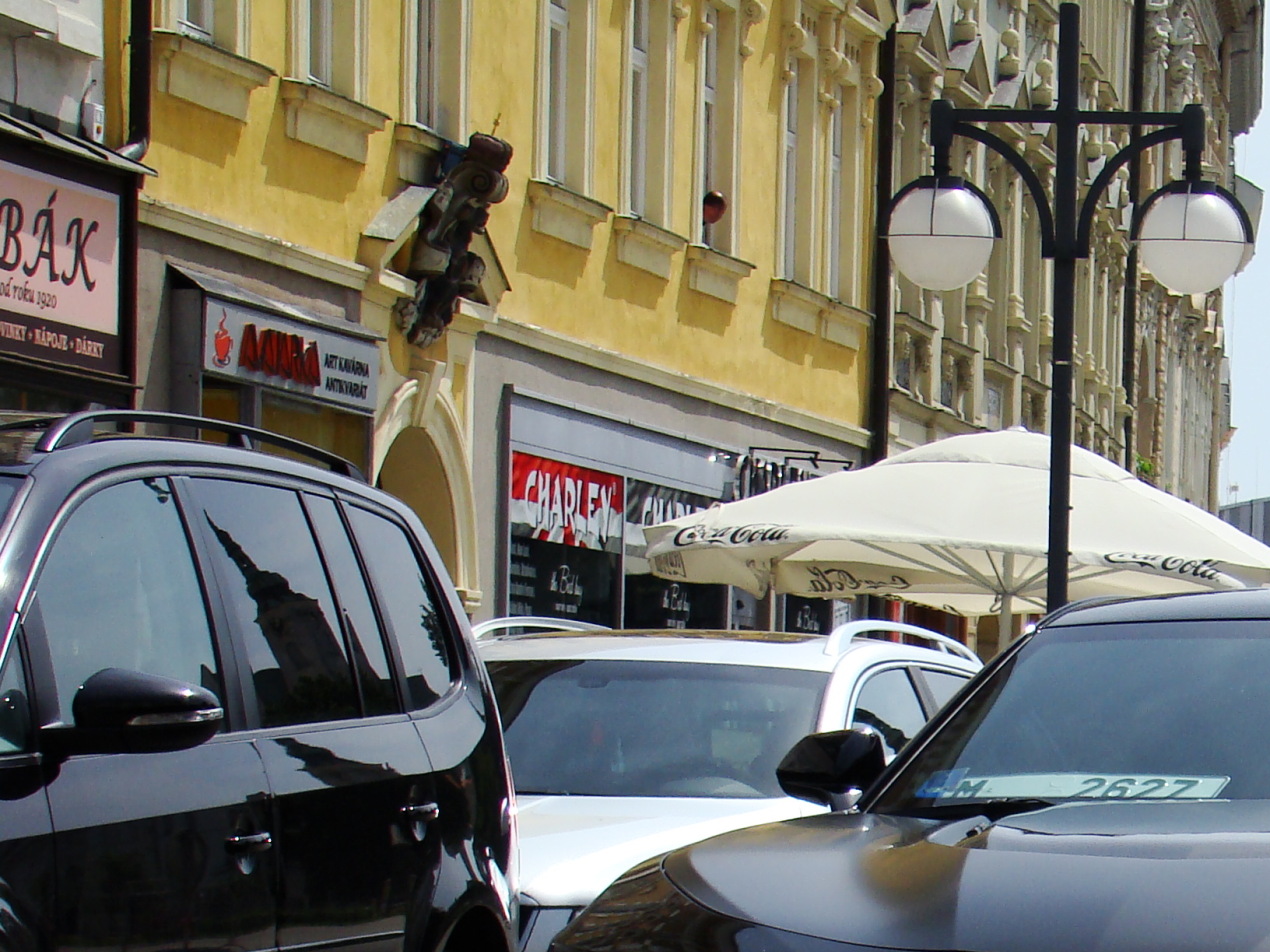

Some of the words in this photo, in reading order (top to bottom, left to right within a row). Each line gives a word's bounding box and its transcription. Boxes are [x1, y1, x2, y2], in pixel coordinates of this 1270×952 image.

[13, 280, 35, 304] roku
[36, 291, 58, 310] 1920
[33, 326, 68, 351] NÁPOJE
[74, 335, 104, 359] DÁRKY
[324, 353, 338, 370] ART
[525, 470, 613, 543] CHARLEY
[1069, 777, 1200, 798] 2627
